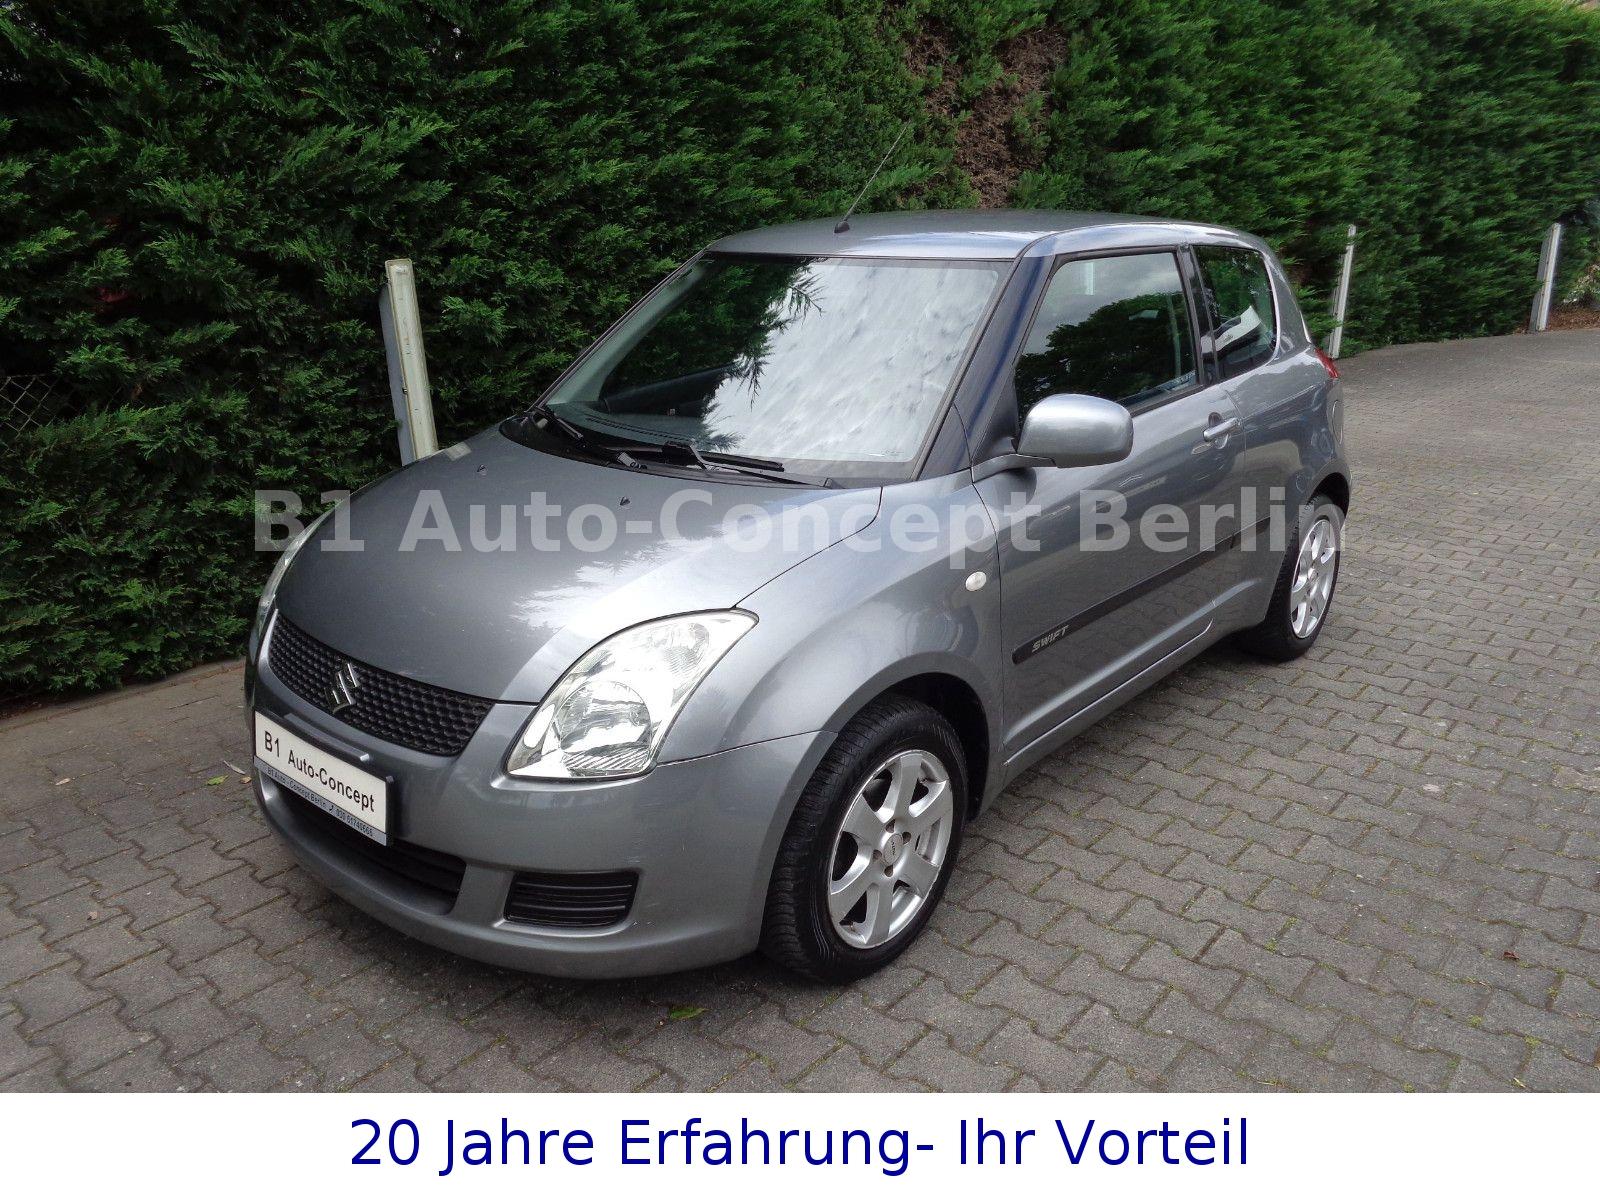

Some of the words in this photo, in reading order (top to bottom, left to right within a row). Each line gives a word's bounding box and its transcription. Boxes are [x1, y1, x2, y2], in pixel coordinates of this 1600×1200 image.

[1031, 624, 1070, 653] SWIFT
[264, 730, 281, 758] B1
[287, 749, 376, 813] Auto-Concept
